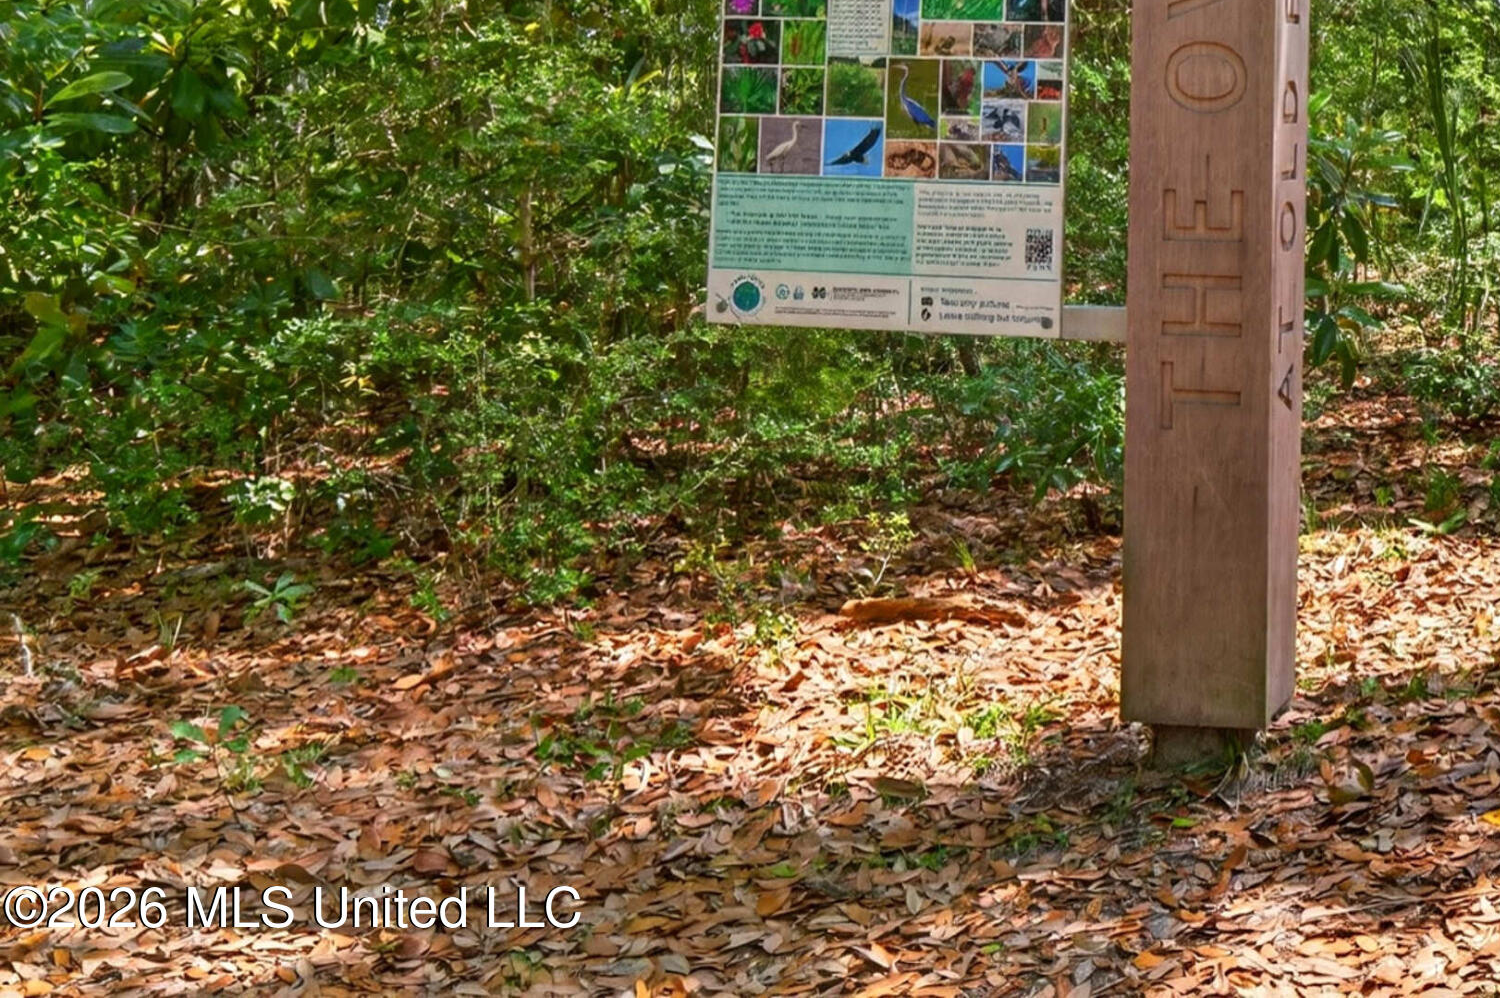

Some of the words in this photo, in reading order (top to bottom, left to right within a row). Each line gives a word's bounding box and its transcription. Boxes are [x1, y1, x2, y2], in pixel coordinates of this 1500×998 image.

[1280, 80, 1299, 252] OLD
[1160, 187, 1244, 430] THE
[1278, 305, 1295, 411] AT
